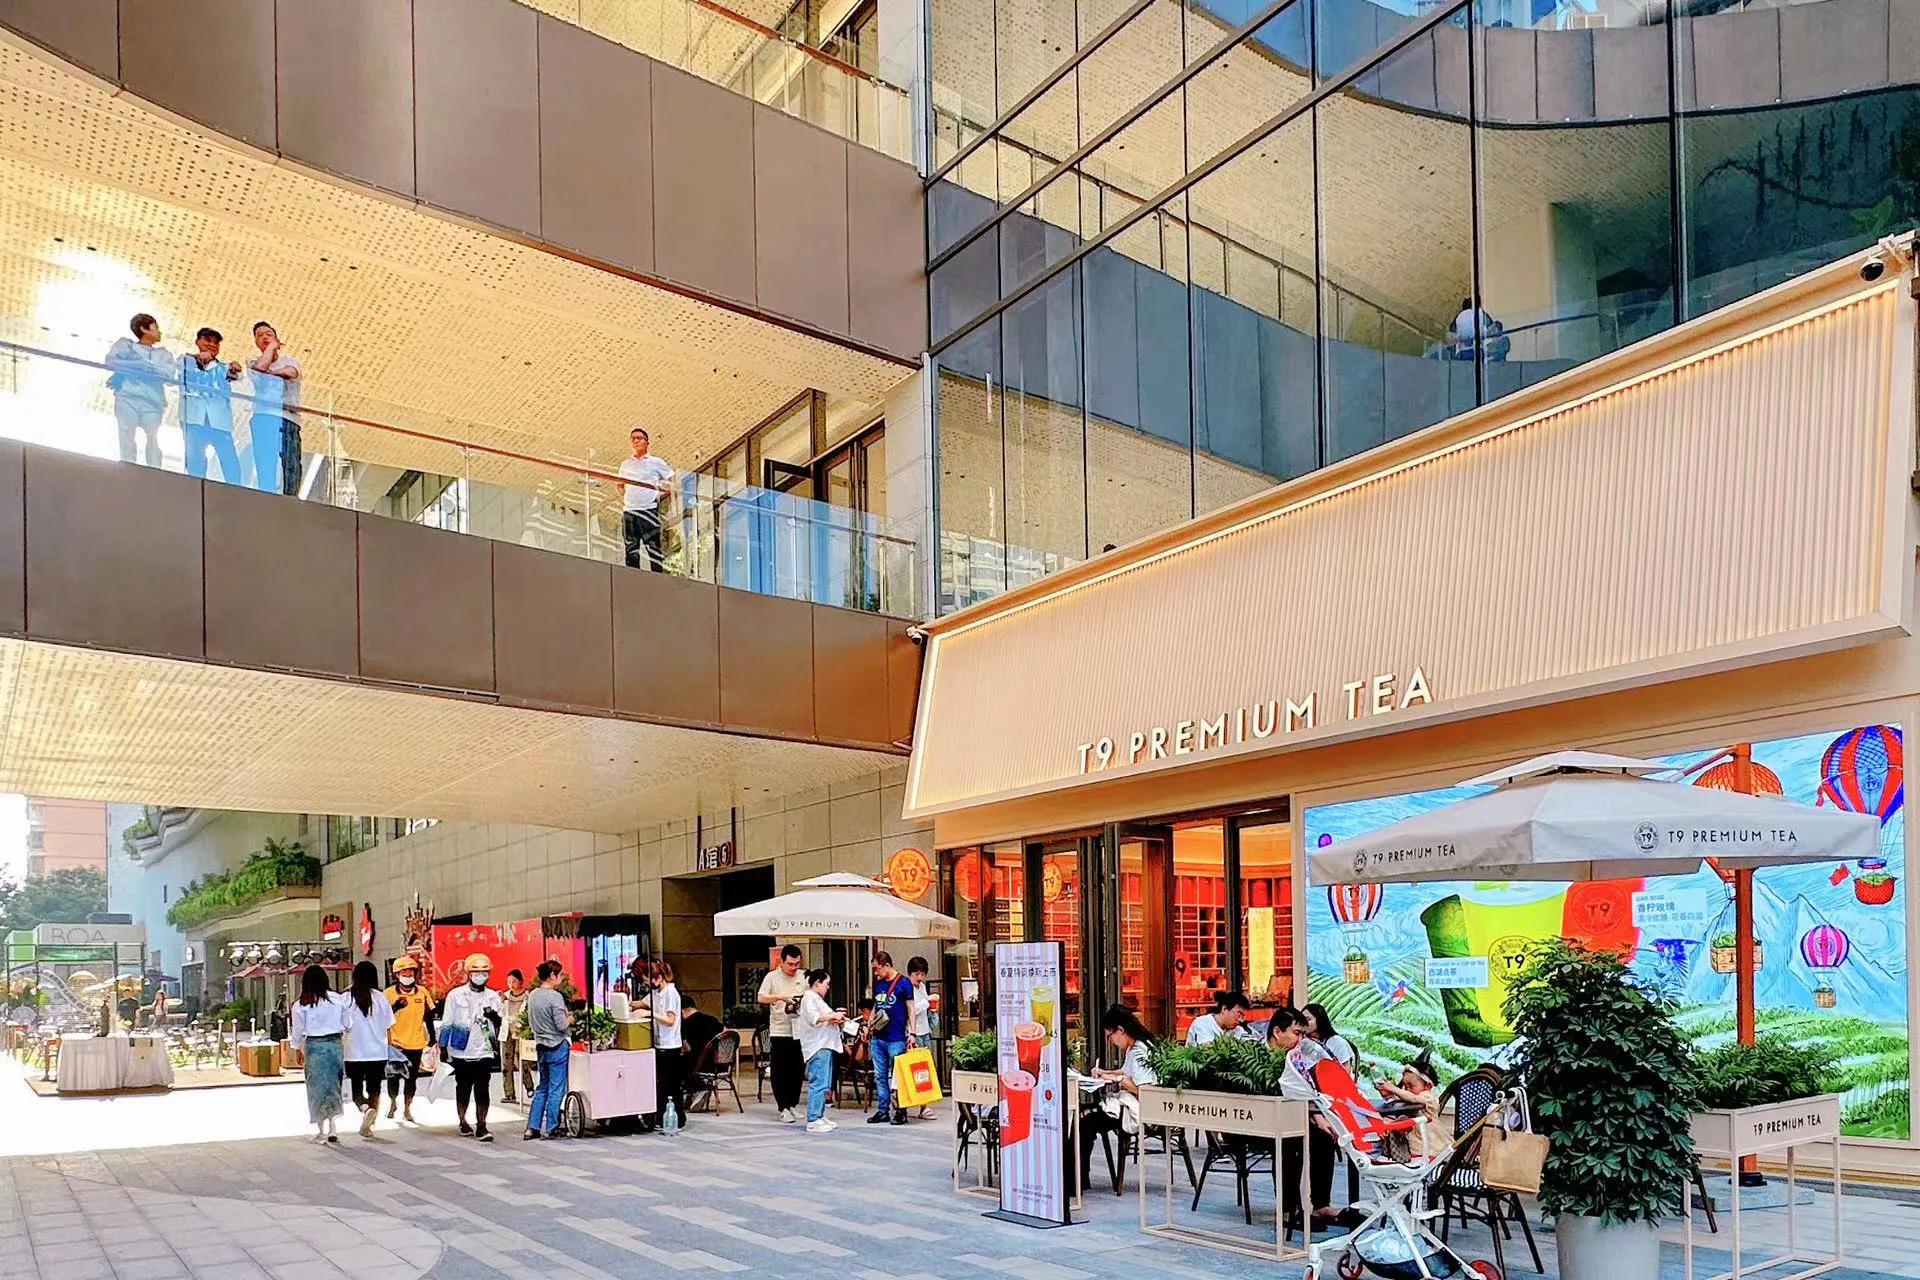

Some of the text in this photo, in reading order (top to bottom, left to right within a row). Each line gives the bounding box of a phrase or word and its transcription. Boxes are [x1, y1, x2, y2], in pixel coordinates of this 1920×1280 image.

[1077, 665, 1433, 774] T9 PREMIUM TEA
[1668, 830, 1684, 843] T9
[1692, 830, 1762, 843] PREMIUM
[1770, 830, 1798, 843] TEA
[1373, 853, 1384, 865] T9
[1388, 847, 1432, 863] PREMIUM
[1437, 844, 1456, 857] TEA
[901, 868, 918, 882] T9
[1585, 902, 1610, 917] T9
[800, 920, 840, 929] PREMIUM
[844, 921, 861, 929] TEA
[1502, 953, 1526, 969] T9
[1162, 1101, 1254, 1121] T9 PREMIUM TEA
[1753, 1113, 1822, 1136] T9 PREMIUM TEA
